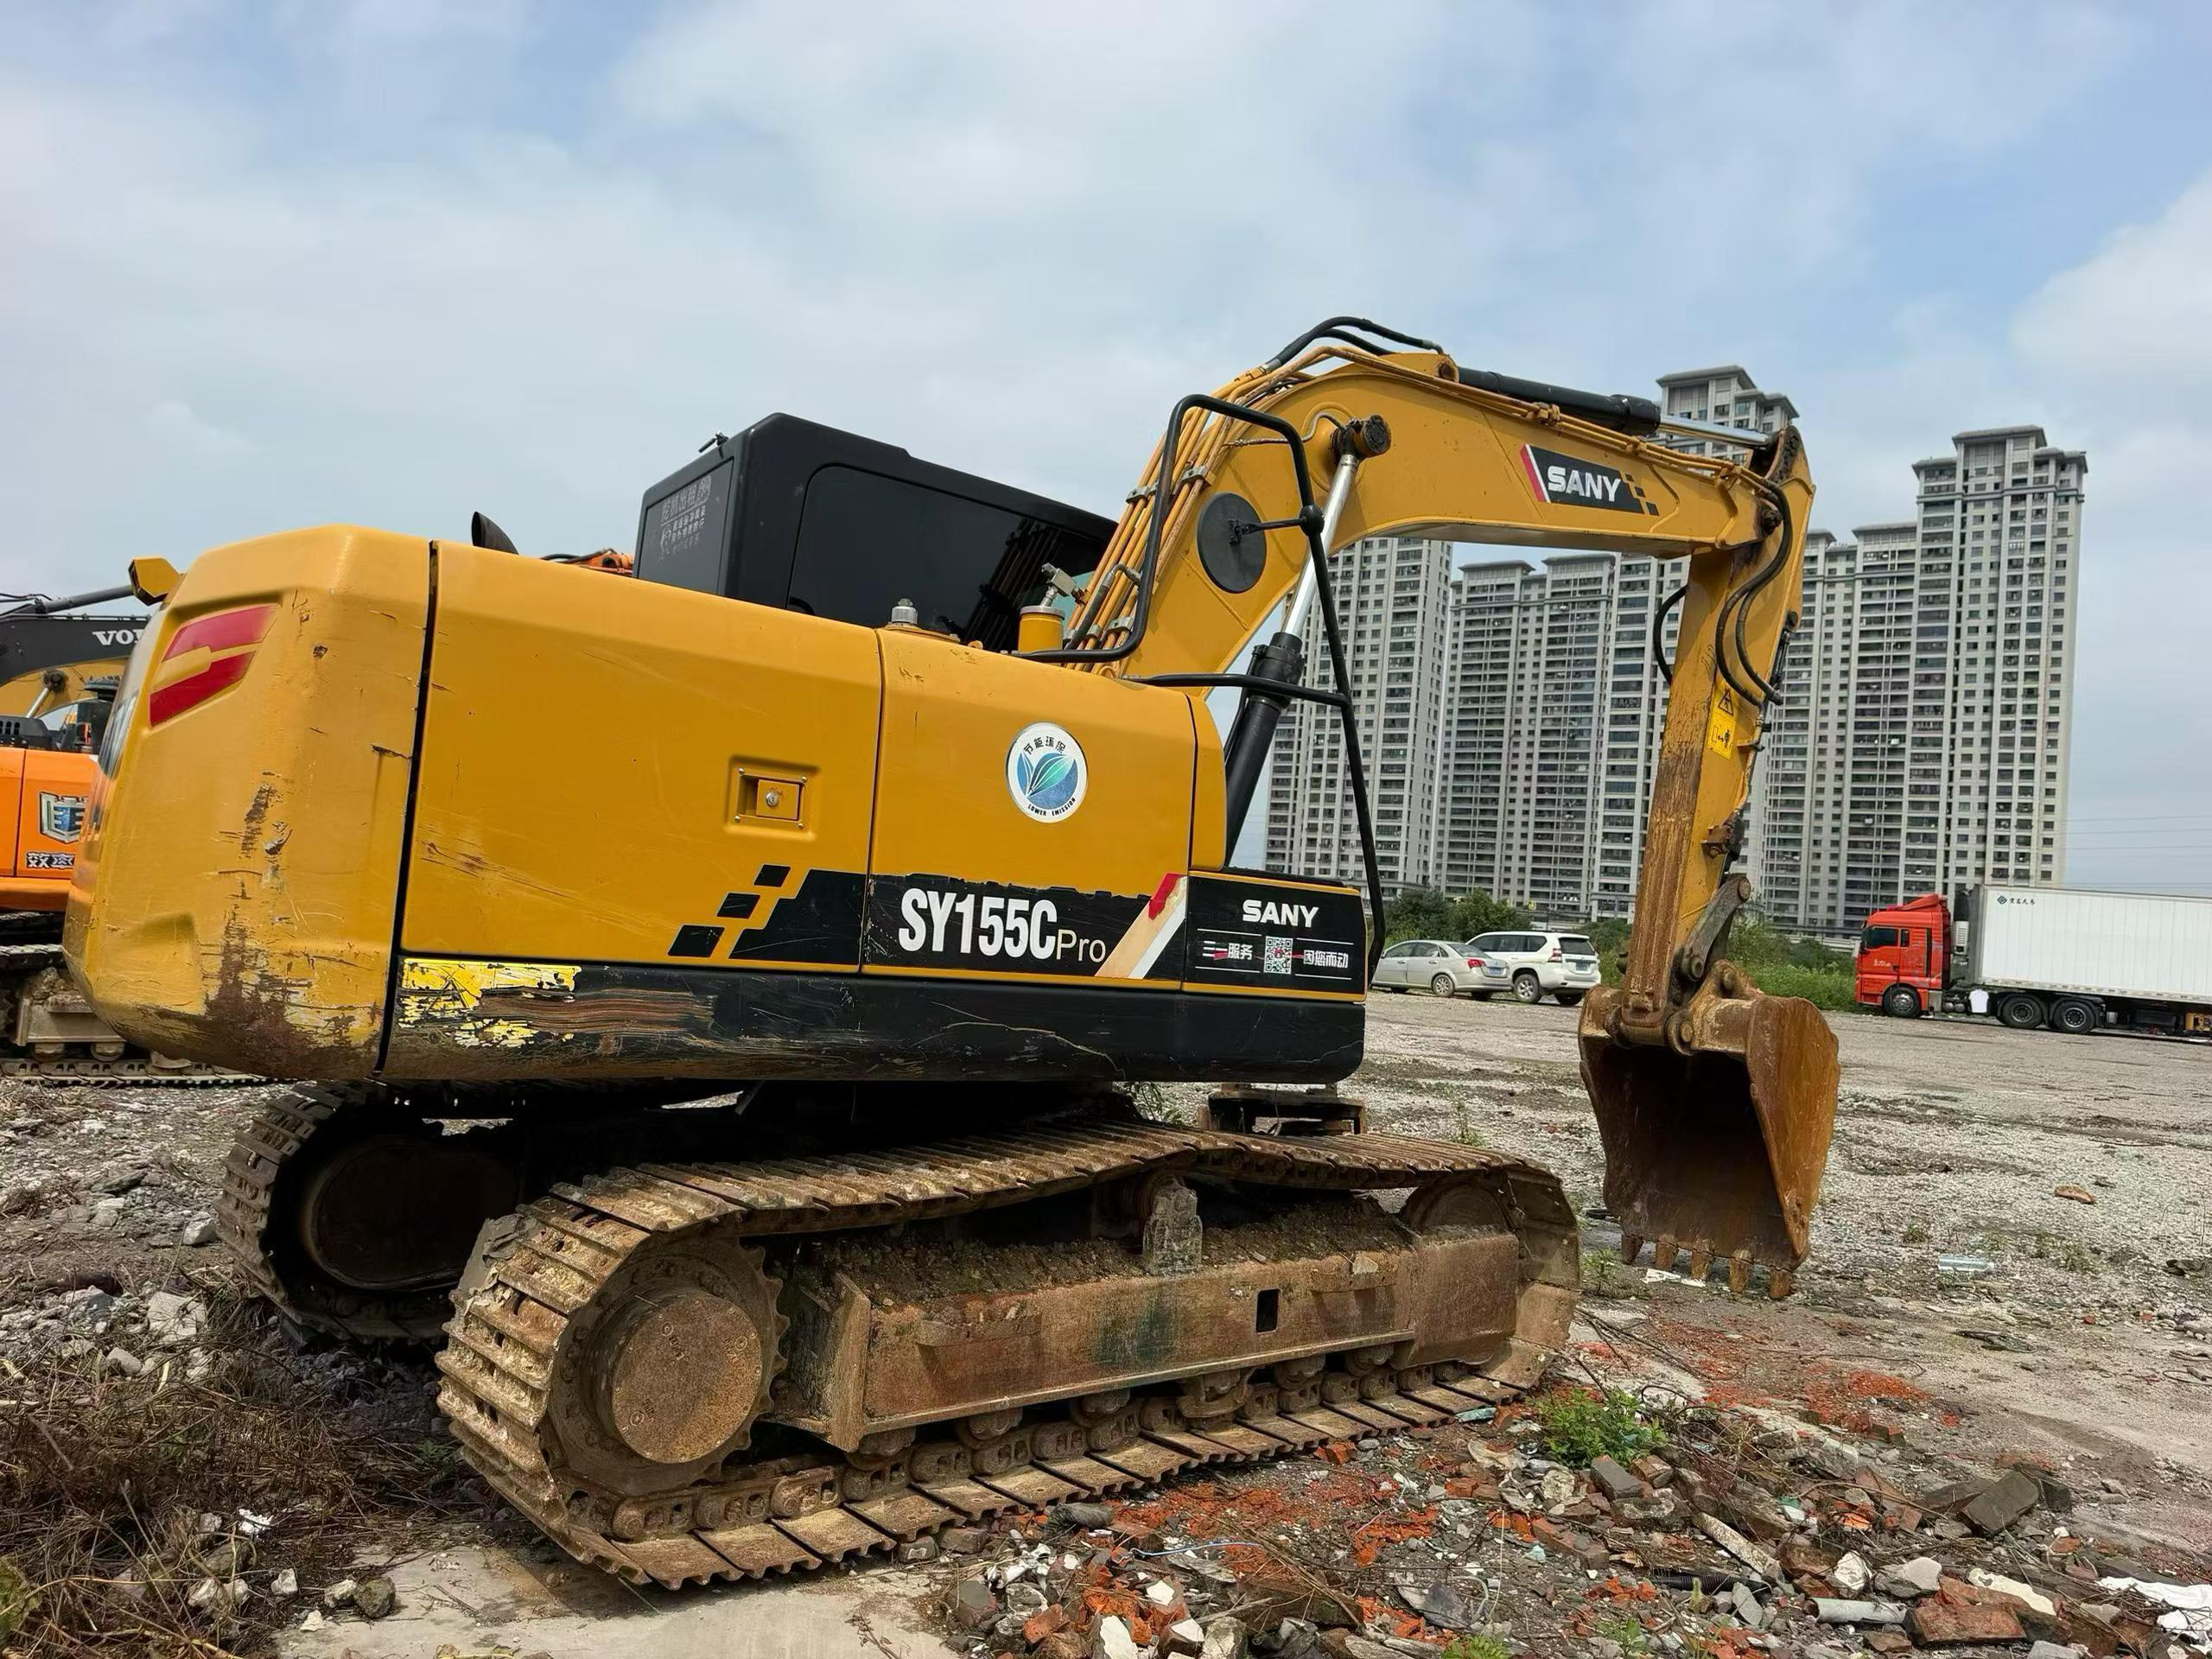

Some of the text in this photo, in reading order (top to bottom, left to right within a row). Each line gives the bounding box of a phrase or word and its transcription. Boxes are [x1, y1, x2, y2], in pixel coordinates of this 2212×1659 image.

[1548, 465, 1621, 502] SANY
[1023, 735, 1066, 754] 节能环保
[1027, 797, 1076, 816] LOWER EMISSION
[899, 887, 1106, 963] SY155C Pro
[1243, 899, 1319, 928] SANY
[1303, 949, 1350, 969] 因您而动
